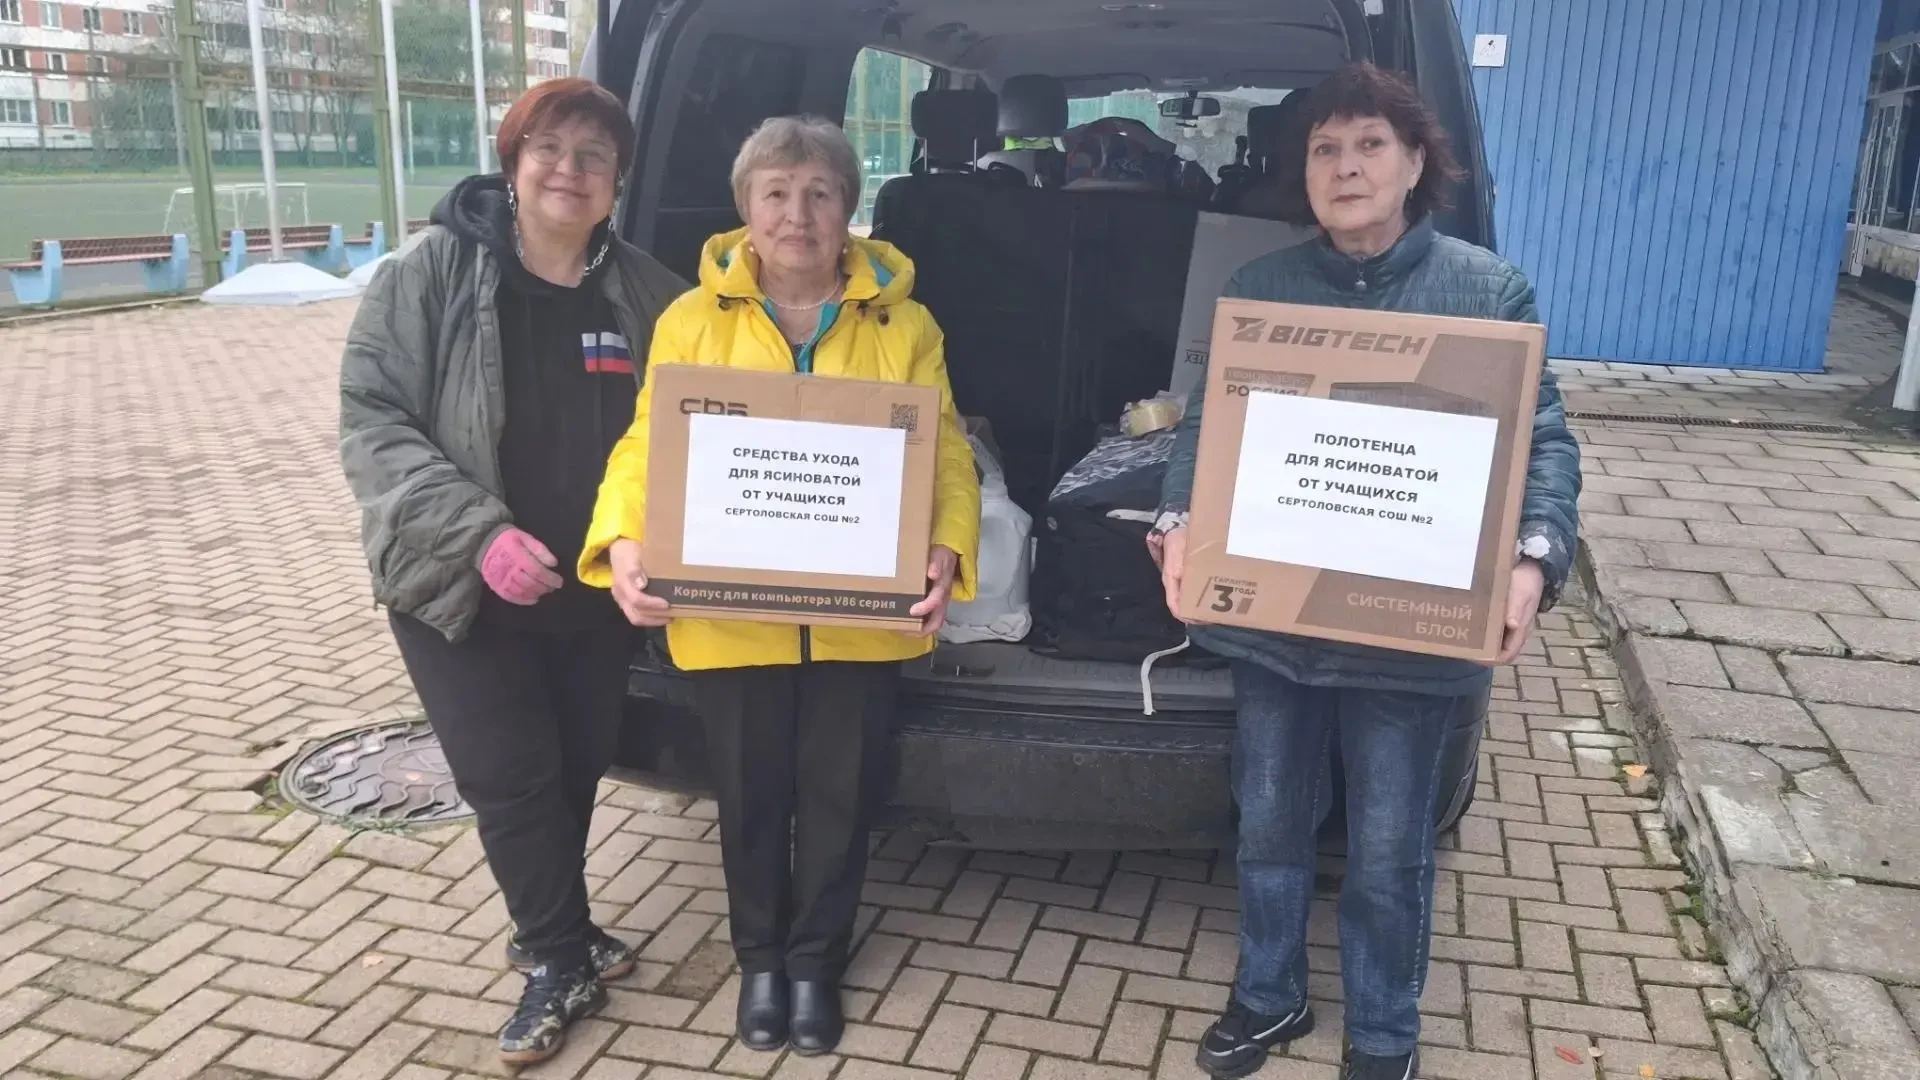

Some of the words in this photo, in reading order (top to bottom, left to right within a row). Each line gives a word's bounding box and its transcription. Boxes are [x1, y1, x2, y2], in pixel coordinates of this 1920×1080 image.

[1268, 324, 1428, 355] BIGTECH
[733, 447, 808, 462] СРЕДСТВА
[813, 453, 859, 466] УХОДА
[1314, 433, 1416, 456] ПОЛОТЕНЦА
[728, 468, 758, 480] ДЛЯ
[763, 470, 860, 486] ЯСИНОВАТОЙ
[1285, 452, 1318, 467] ДЛЯ
[1324, 457, 1438, 482] ЯСИНОВАТОЙ
[742, 489, 761, 500] ОТ
[766, 491, 845, 506] УЧАЩИХСЯ
[1299, 478, 1320, 490] ОТ
[1325, 480, 1418, 503] УЧАЩИХСЯ
[725, 507, 810, 521] СЕРТОЛОВСКАЯ
[814, 513, 838, 522] СОШ
[842, 515, 859, 523] №2
[1278, 496, 1374, 517] СЕРТОЛОВСКАЯ
[1379, 509, 1407, 522] СОШ
[1411, 514, 1433, 525] №2
[674, 586, 721, 600] Корпус
[723, 589, 749, 601] для
[751, 591, 831, 607] компьютера
[834, 595, 856, 606] V86
[859, 598, 896, 610] серия
[1211, 585, 1233, 613] 3
[1347, 592, 1472, 621] СИСТЕМНЫЙ
[1415, 621, 1470, 641] БЛОК
